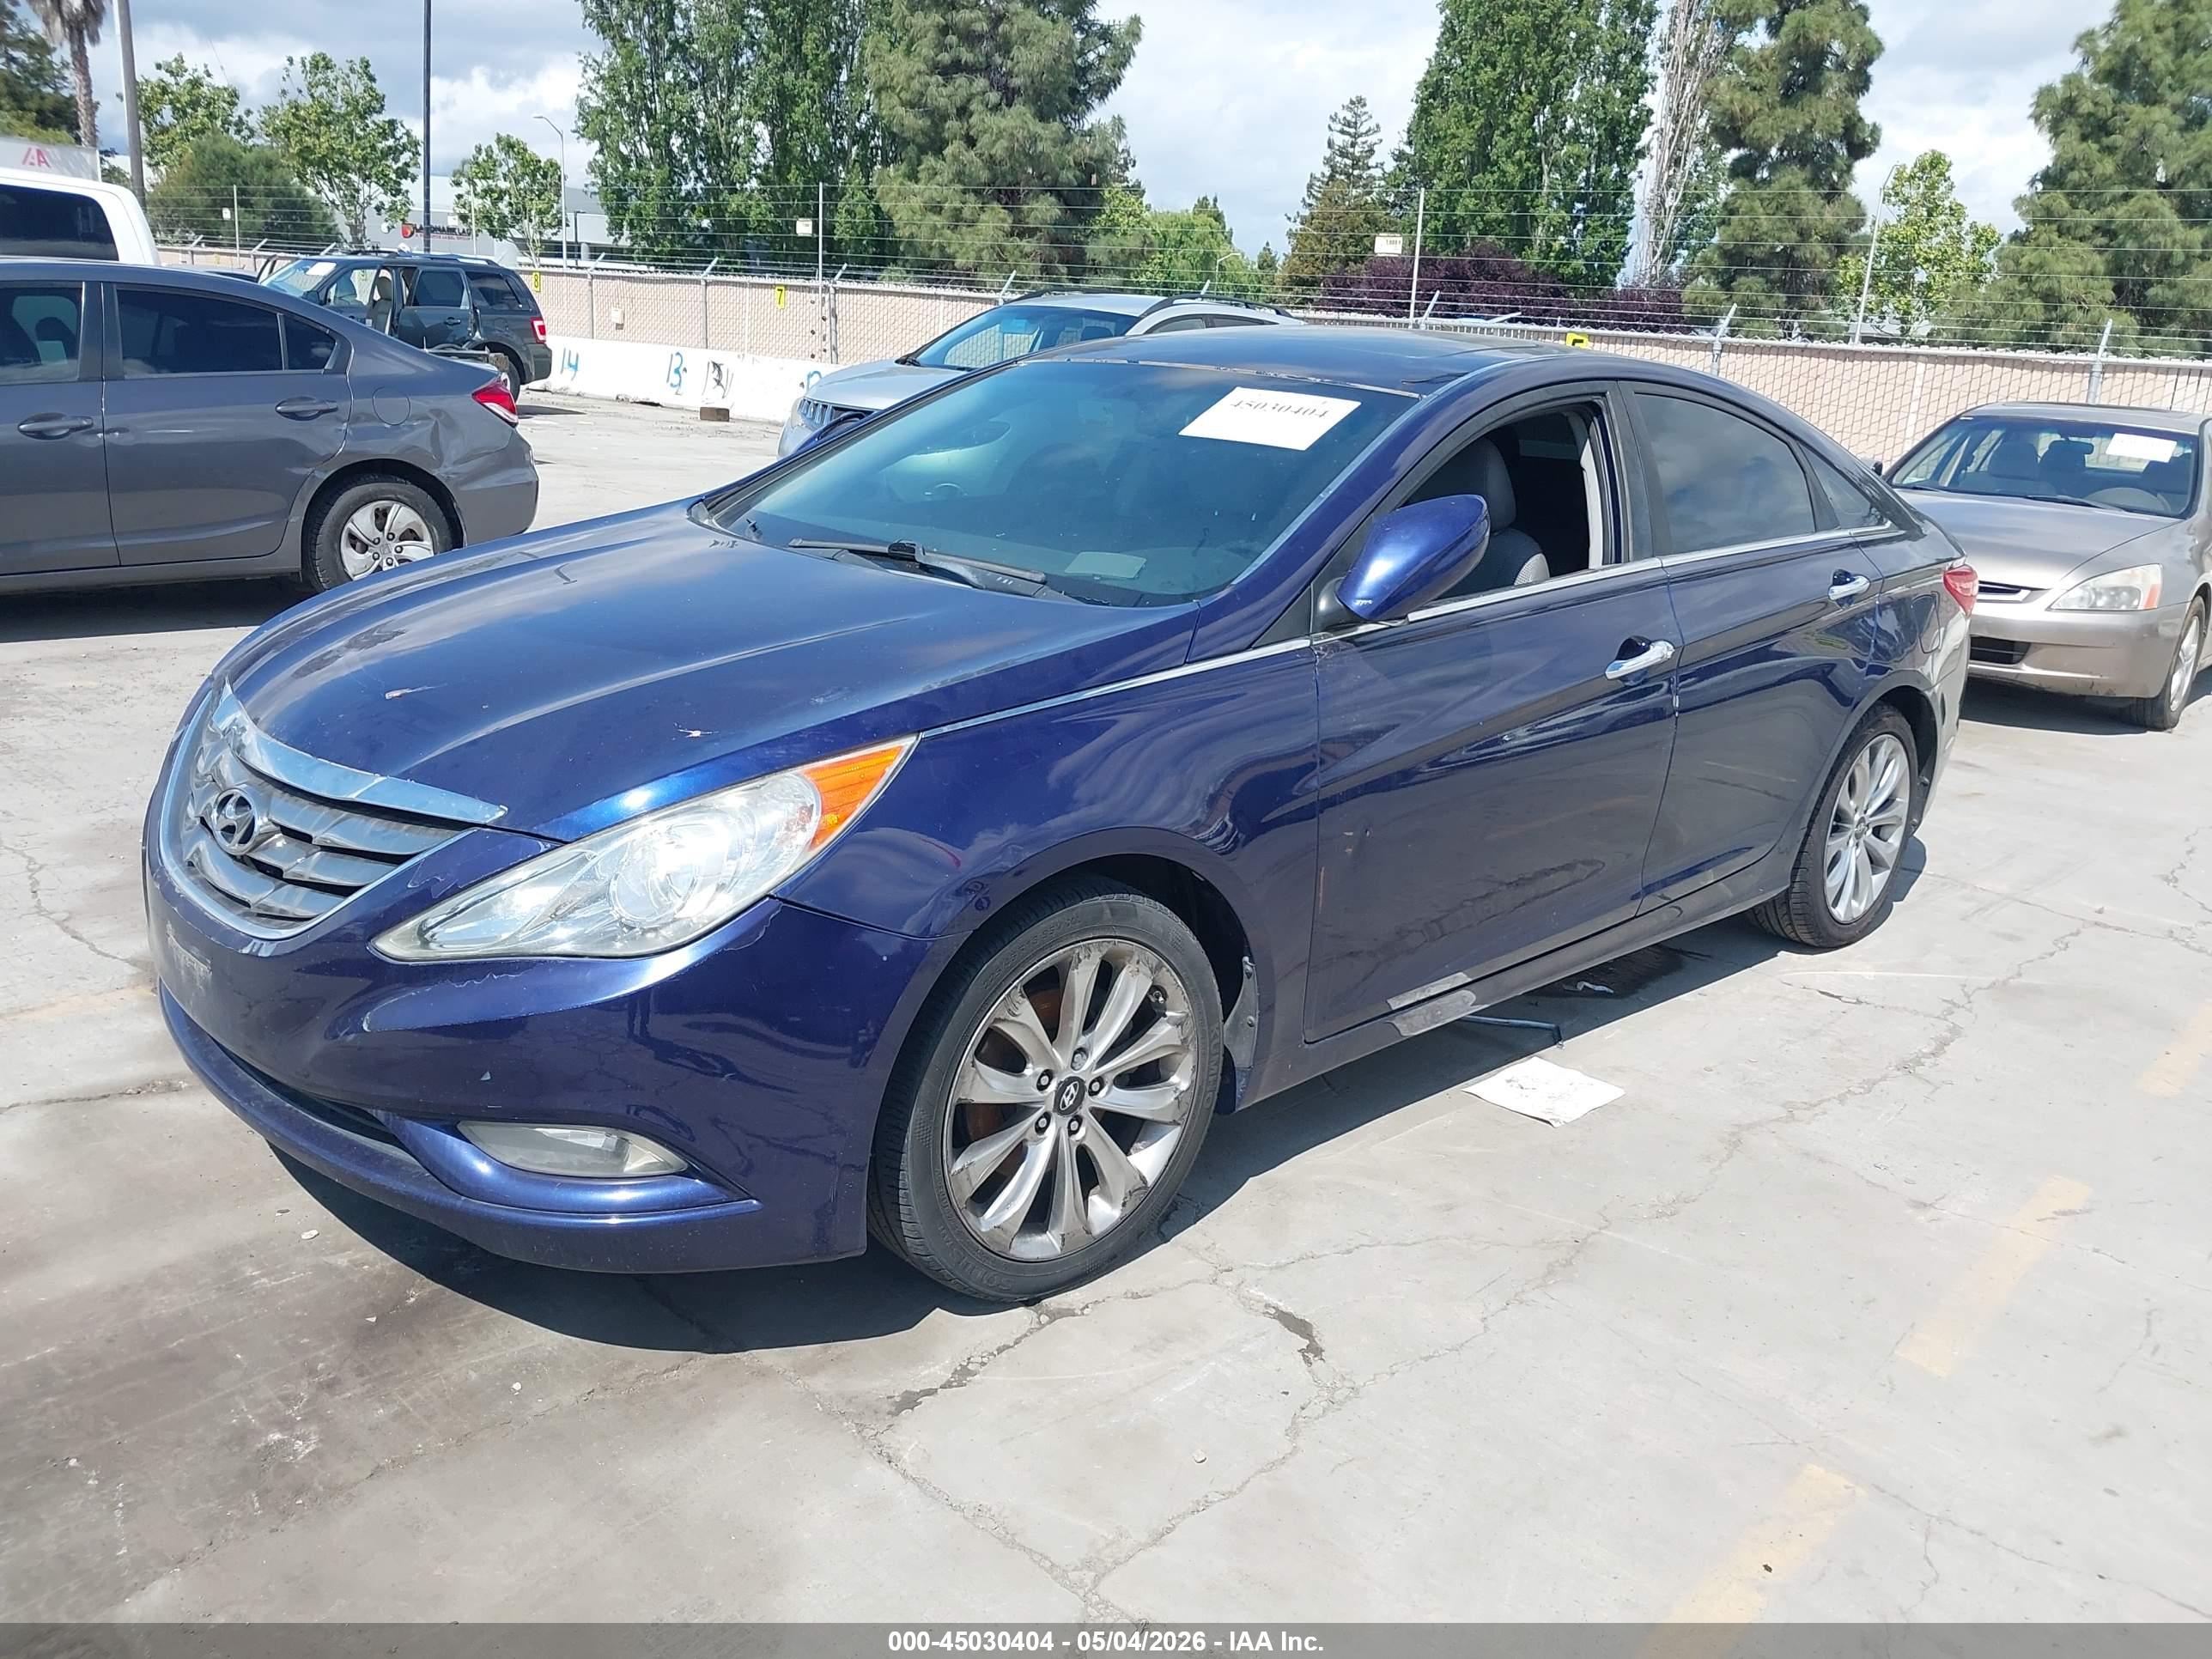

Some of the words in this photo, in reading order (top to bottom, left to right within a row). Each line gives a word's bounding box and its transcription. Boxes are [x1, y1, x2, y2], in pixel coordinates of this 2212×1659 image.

[534, 273, 539, 289] 8
[777, 288, 783, 305] 7
[560, 347, 580, 381] 14
[666, 351, 684, 388] 13
